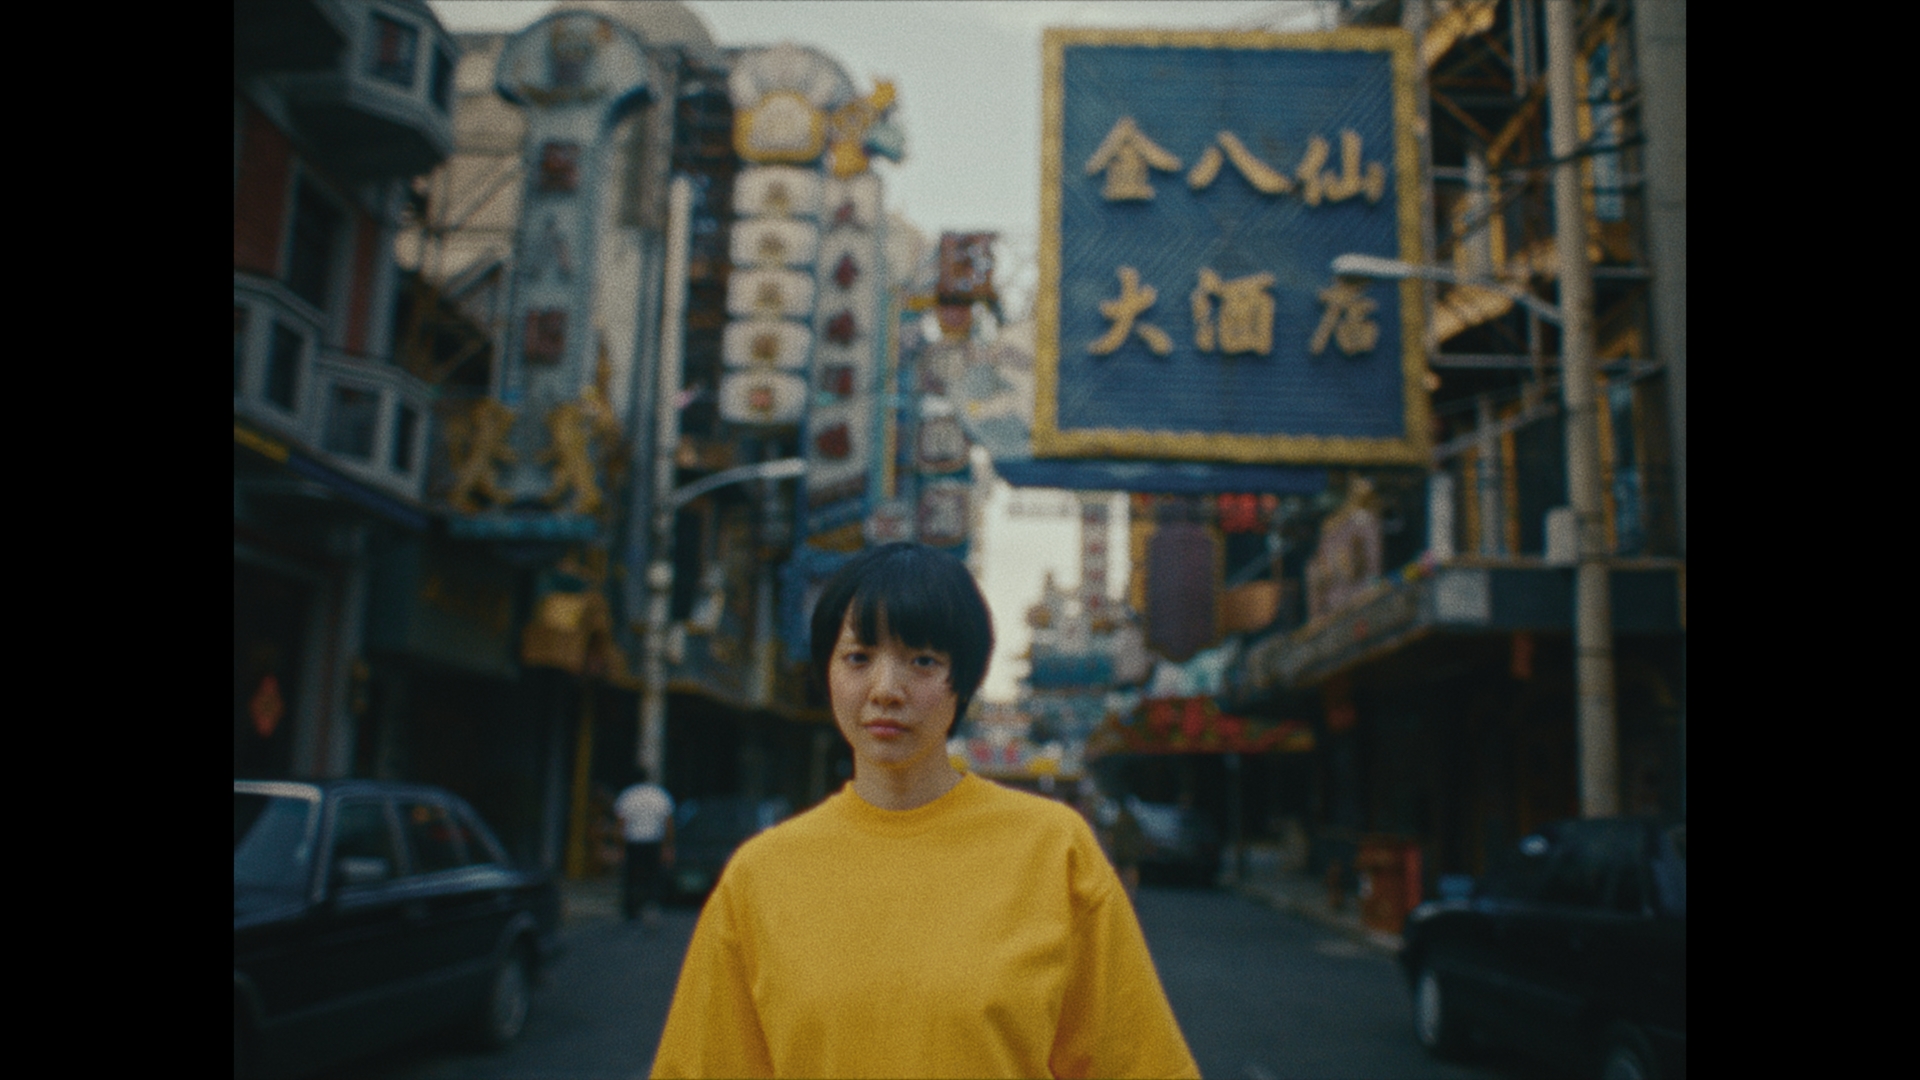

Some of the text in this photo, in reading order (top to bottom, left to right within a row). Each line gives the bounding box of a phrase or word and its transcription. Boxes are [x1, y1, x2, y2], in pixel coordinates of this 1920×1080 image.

[1087, 117, 1386, 206] 金八仙
[1089, 267, 1380, 355] 大酒店
